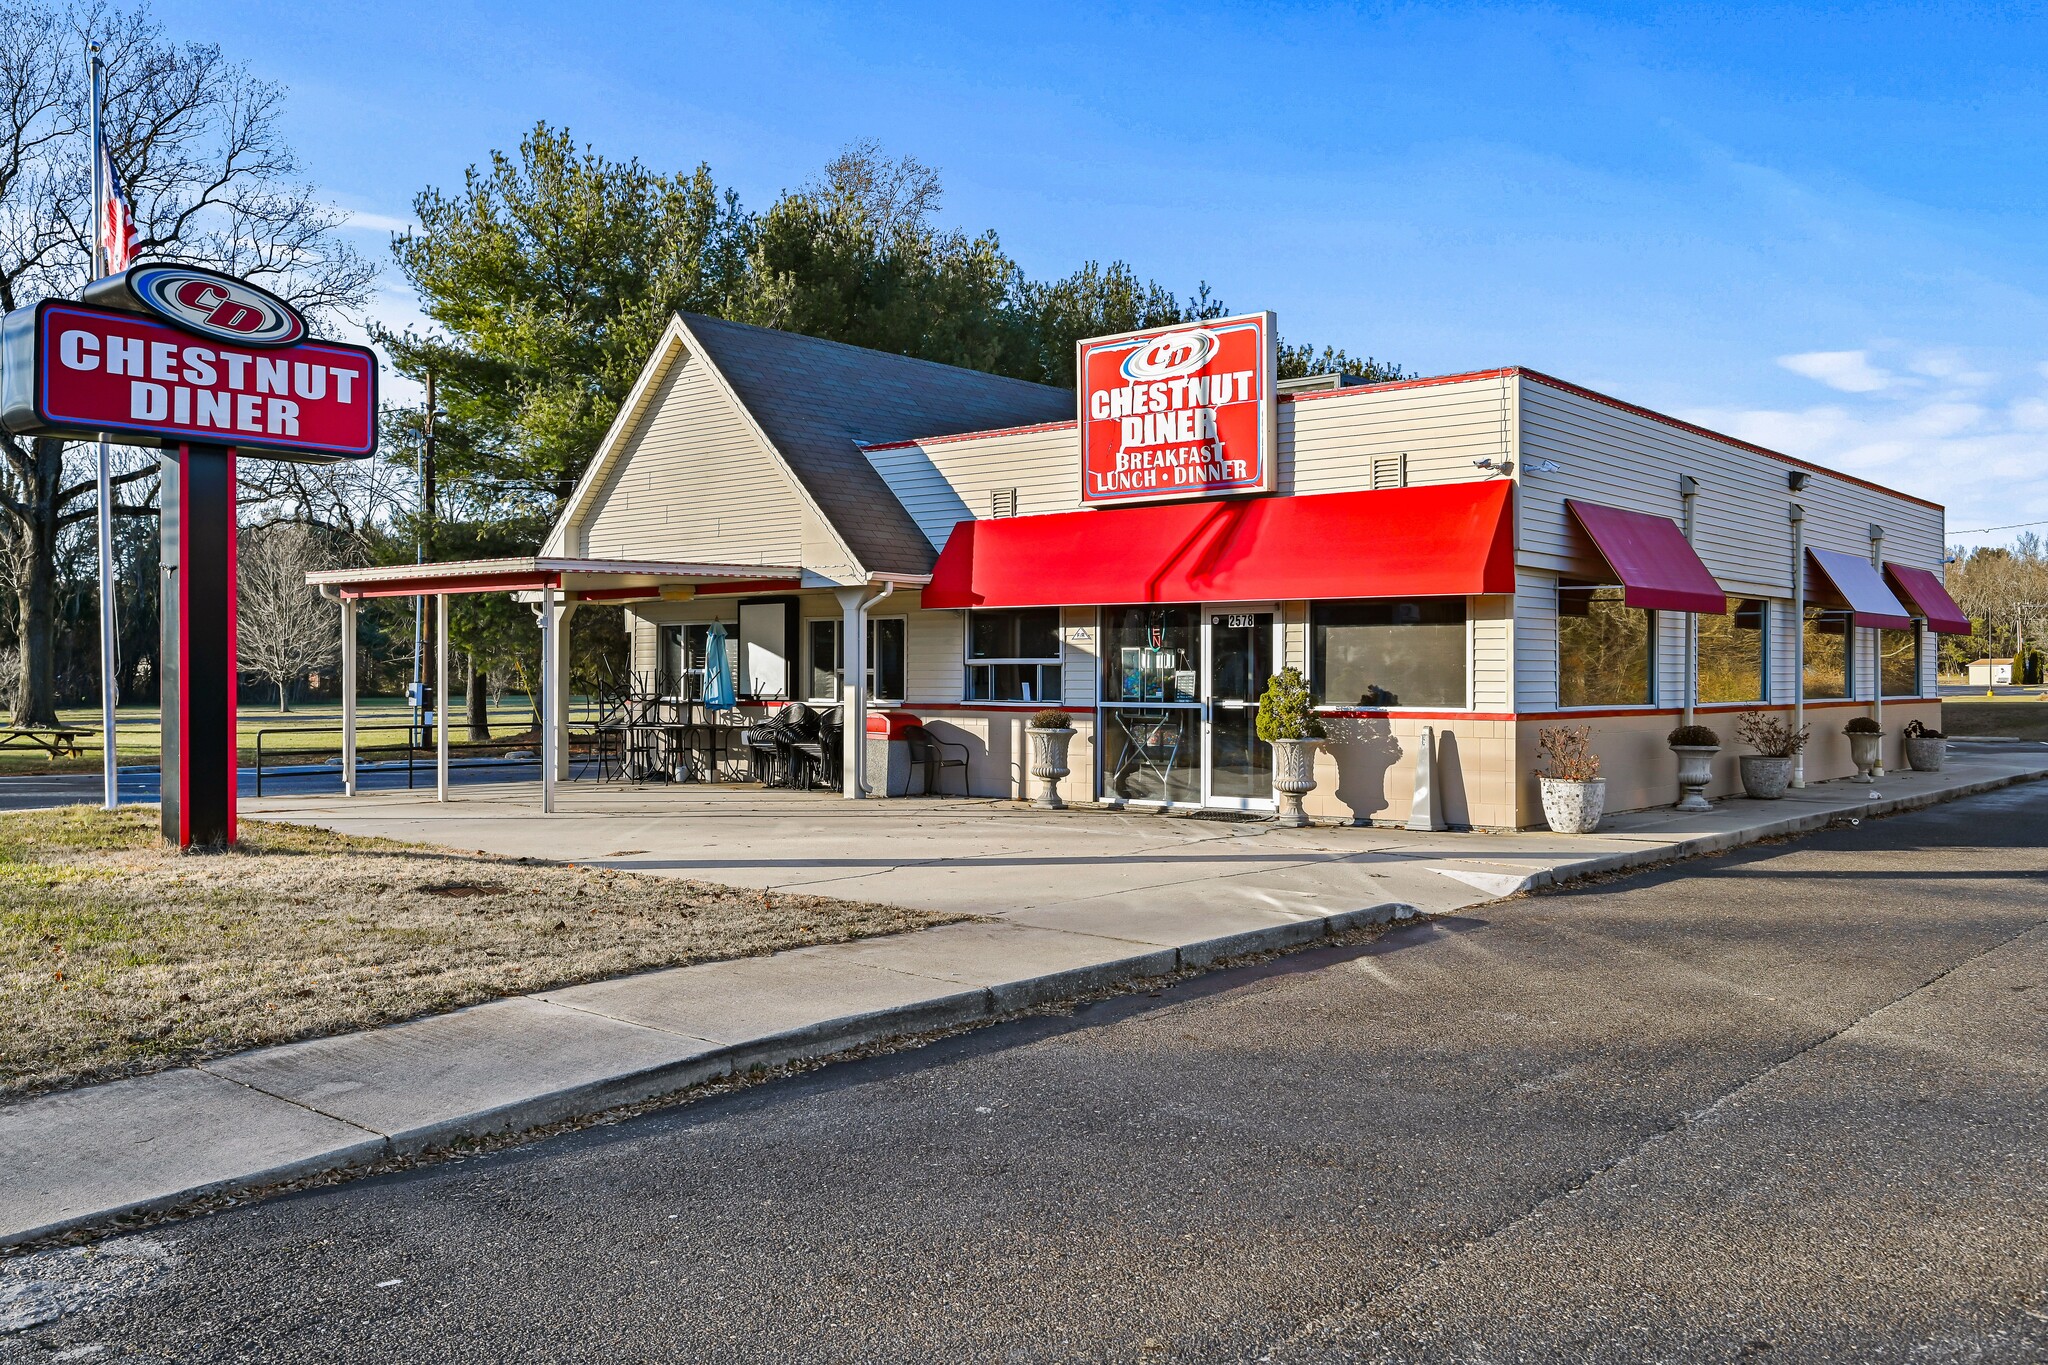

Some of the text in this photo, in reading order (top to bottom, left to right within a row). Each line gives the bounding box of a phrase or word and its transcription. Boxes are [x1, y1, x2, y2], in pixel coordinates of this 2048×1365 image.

[175, 280, 266, 334] CD
[59, 329, 360, 404] CHESTNUT
[130, 380, 300, 437] DINER
[1091, 370, 1253, 420] CHESTNUT
[1120, 408, 1218, 448] DINER
[1096, 459, 1248, 492] LUNCH DINNER
[1115, 441, 1226, 472] BREAKFAST
[1229, 614, 1253, 627] 2578
